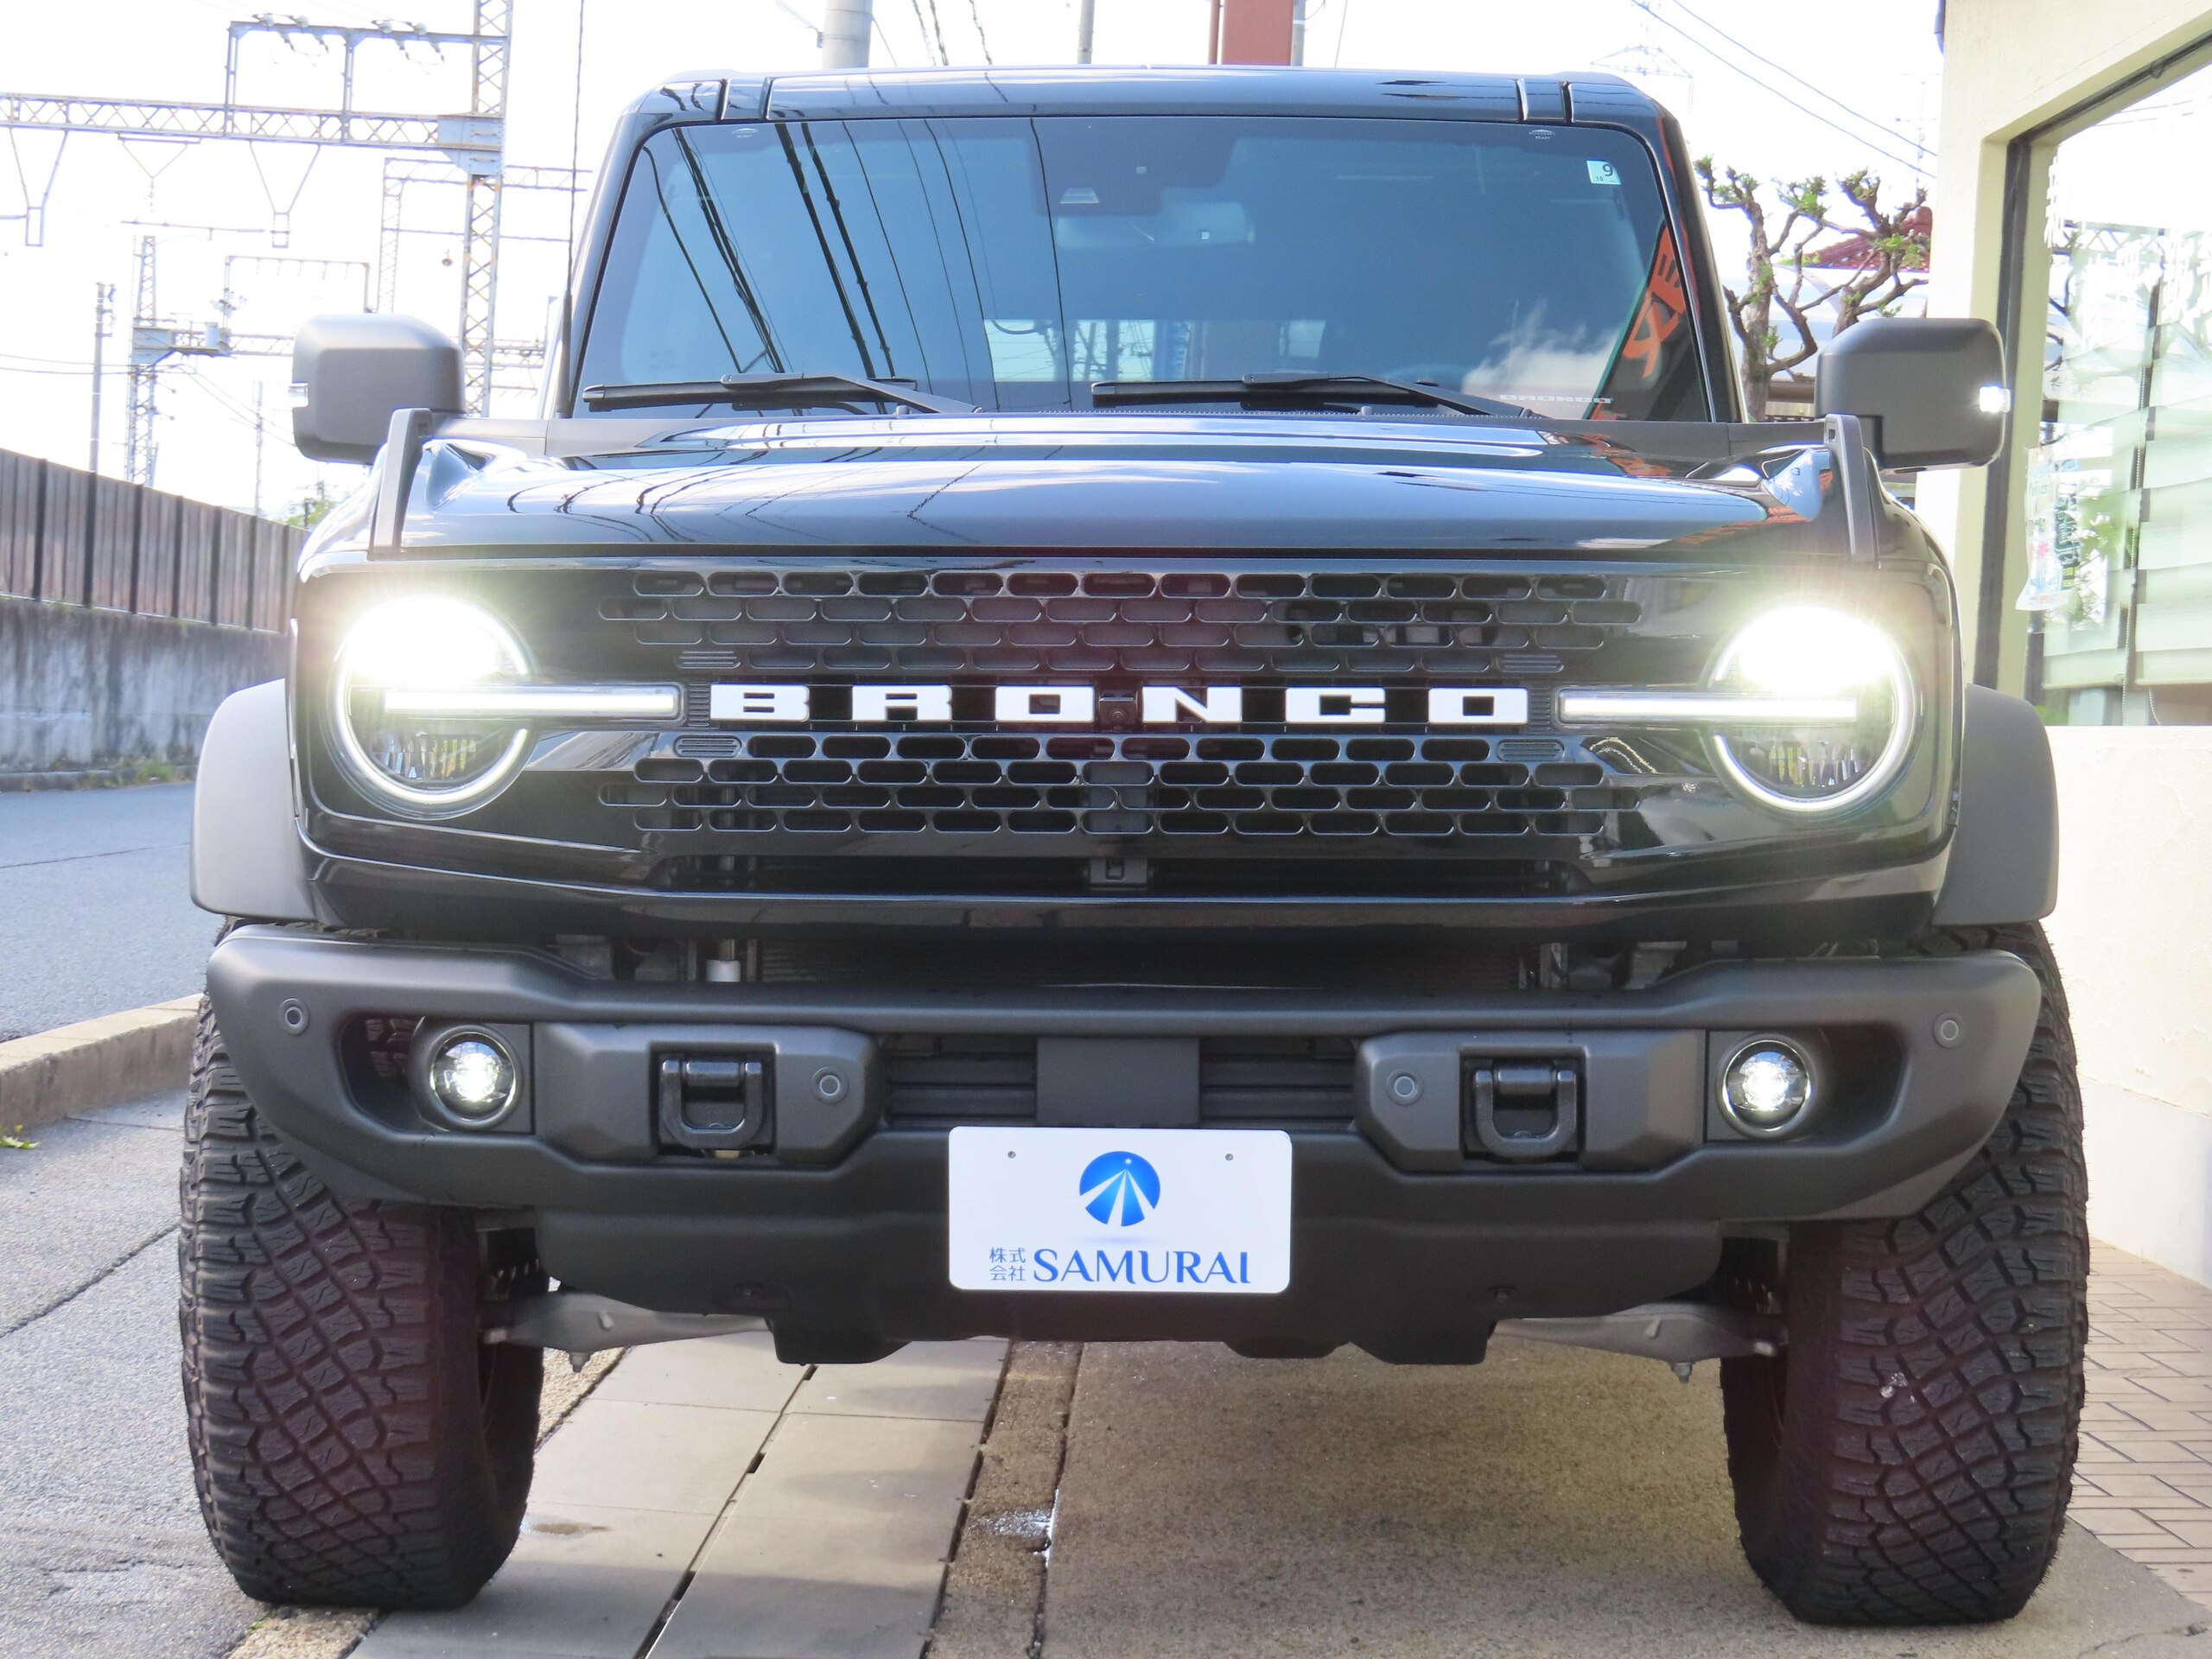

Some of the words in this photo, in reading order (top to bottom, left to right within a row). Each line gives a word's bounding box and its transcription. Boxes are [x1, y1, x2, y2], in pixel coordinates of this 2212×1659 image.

[1602, 164, 1613, 176] 9
[709, 684, 1529, 724] BRONCO
[989, 1247, 1026, 1263] 株式
[989, 1265, 1026, 1281] 会社
[1033, 1249, 1251, 1284] SAMURAI
